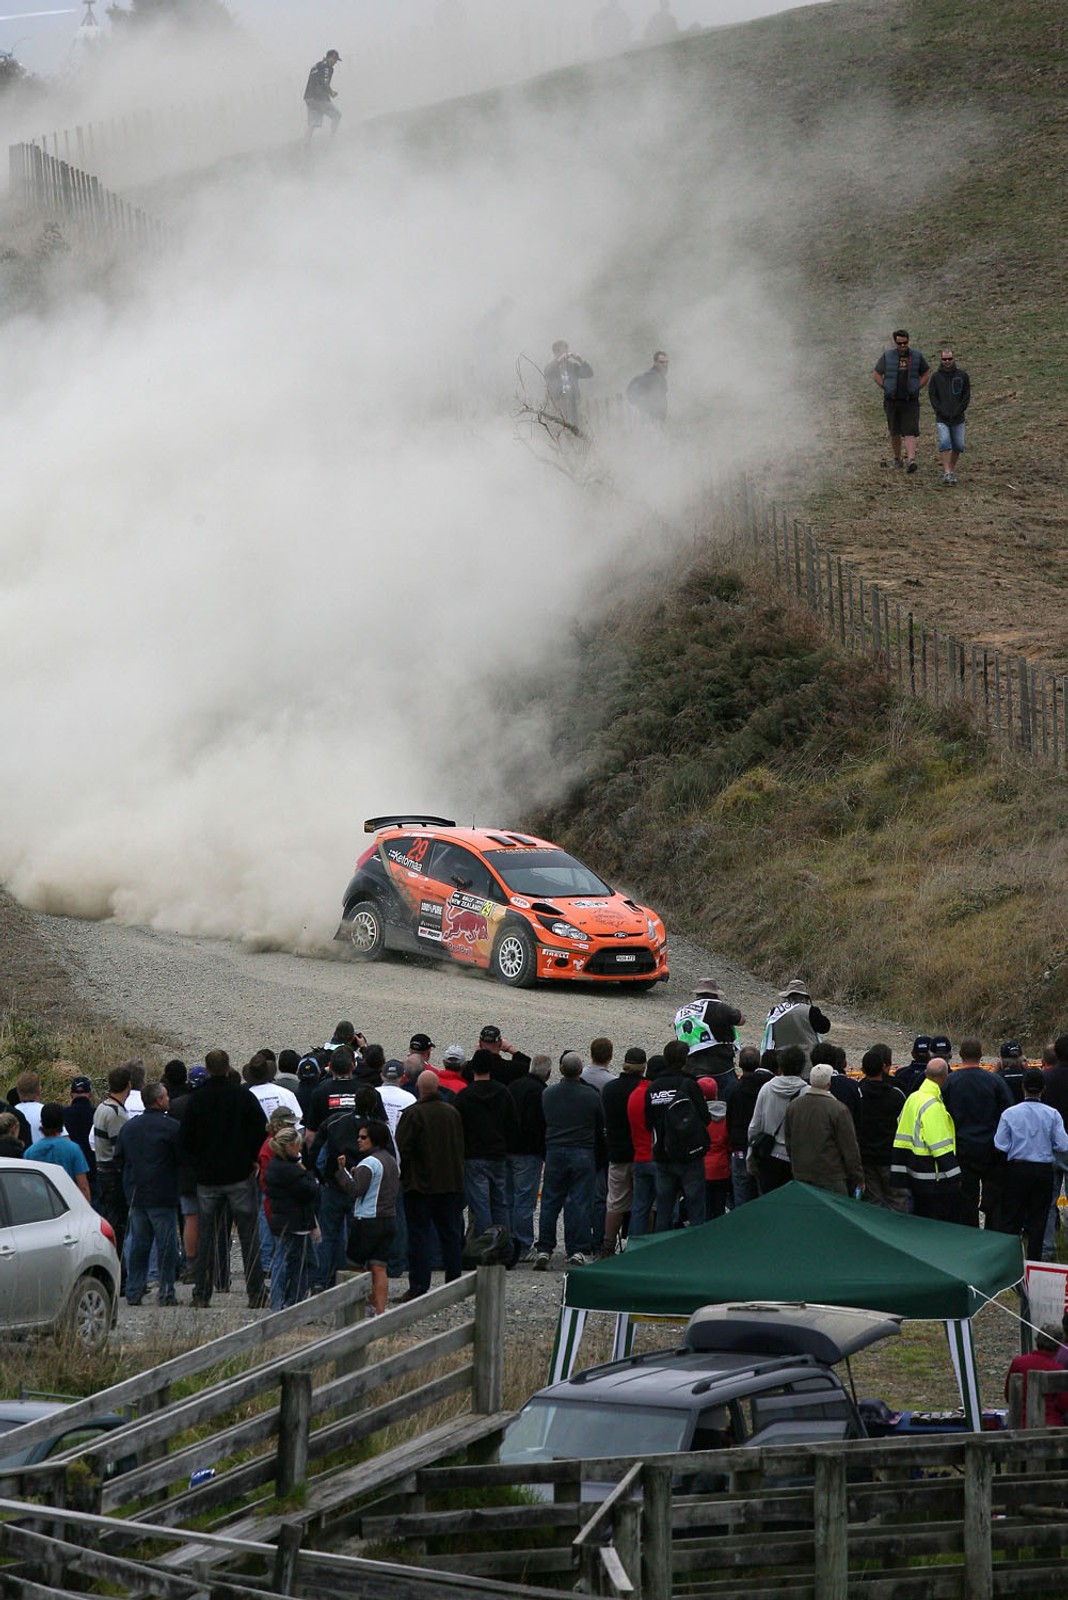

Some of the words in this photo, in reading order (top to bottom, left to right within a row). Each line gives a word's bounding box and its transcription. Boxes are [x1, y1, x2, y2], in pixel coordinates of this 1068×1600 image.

[407, 838, 429, 862] 29
[393, 851, 422, 872] Ketomaa
[461, 900, 482, 911] ZEALAND
[542, 949, 570, 959] PIRELLI
[650, 1089, 677, 1099] WRC
